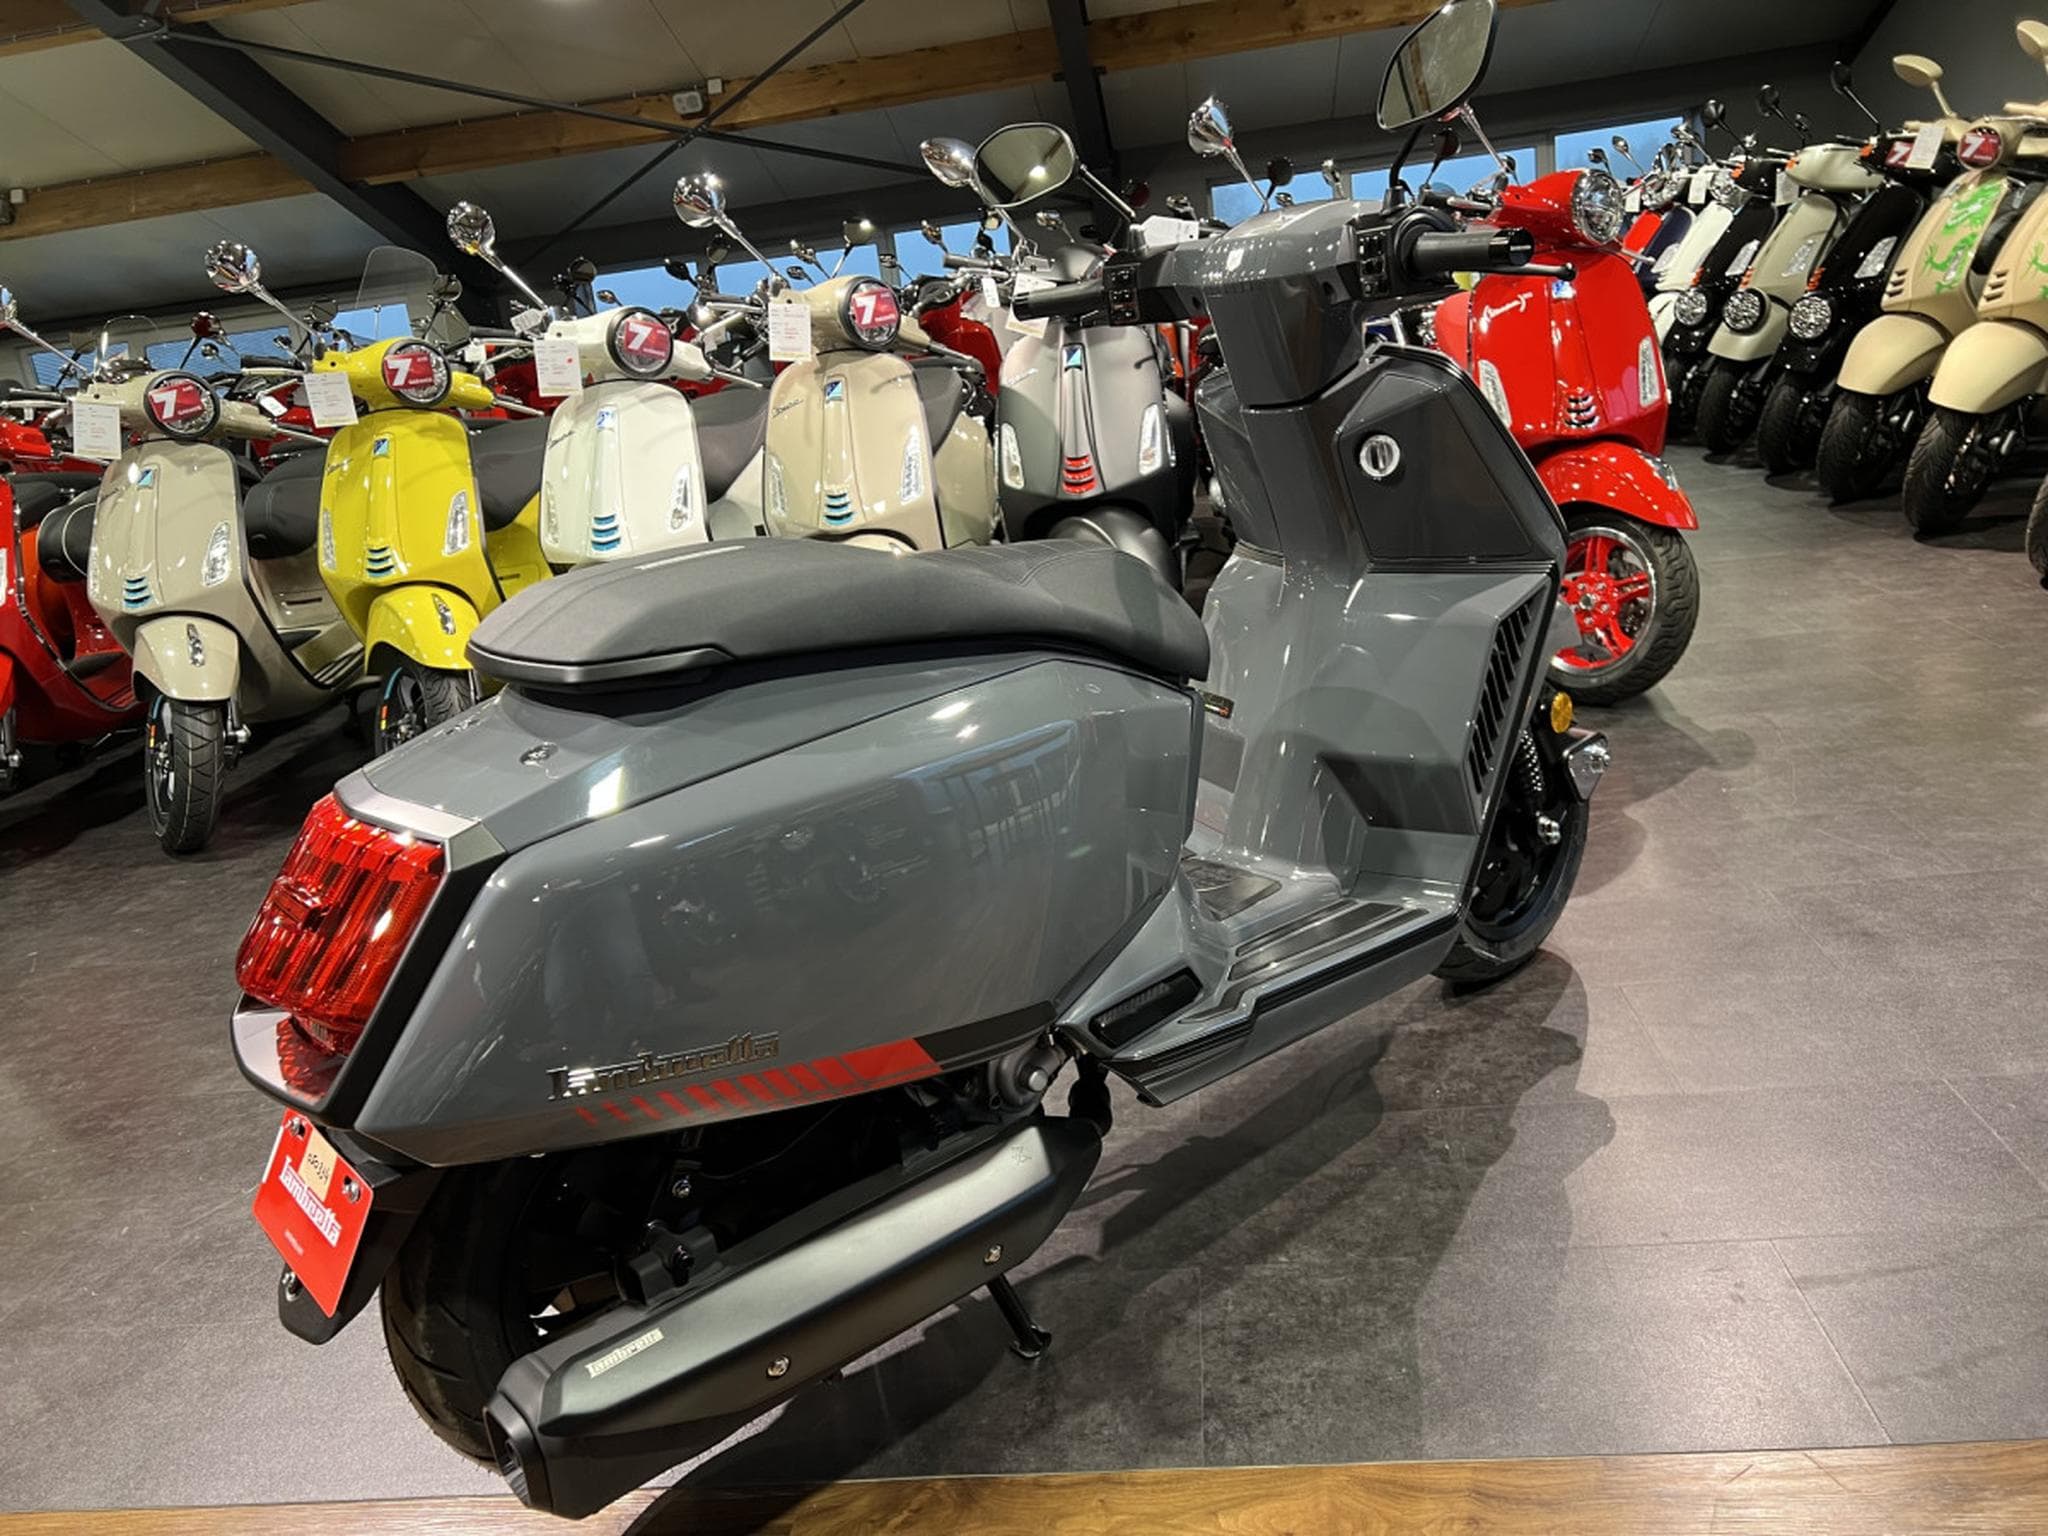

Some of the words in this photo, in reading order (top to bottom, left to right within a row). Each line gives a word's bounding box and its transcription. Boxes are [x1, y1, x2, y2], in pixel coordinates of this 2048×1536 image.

[1888, 142, 1911, 163] 7
[1961, 134, 1985, 158] 7
[854, 295, 877, 325] 7
[627, 323, 653, 350] 7
[386, 358, 412, 386] 7
[152, 390, 177, 419] 7
